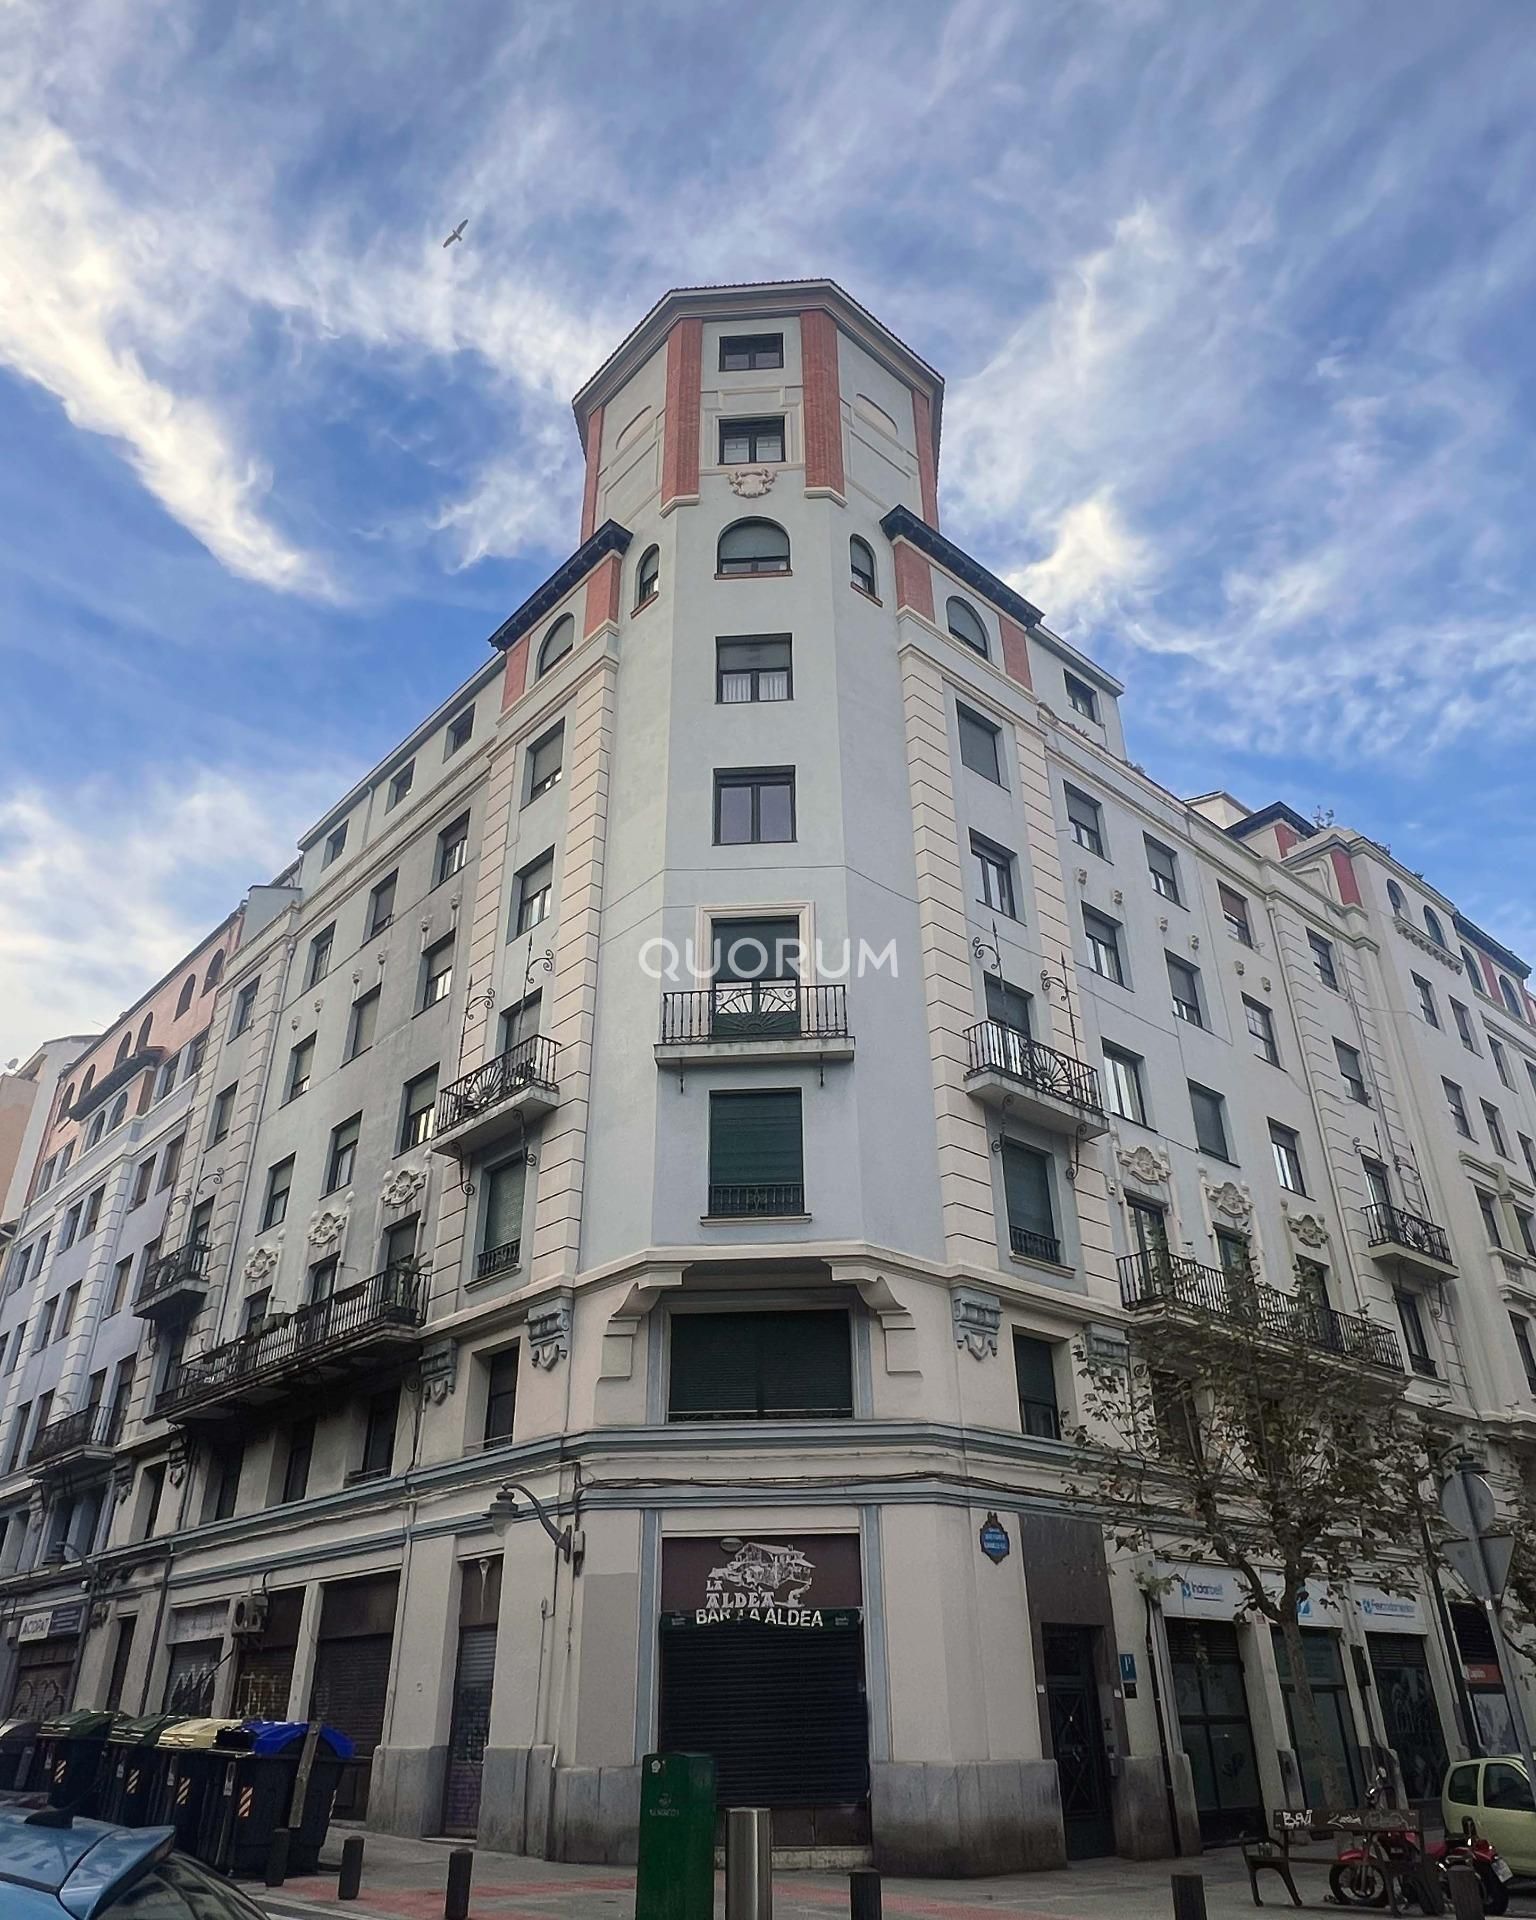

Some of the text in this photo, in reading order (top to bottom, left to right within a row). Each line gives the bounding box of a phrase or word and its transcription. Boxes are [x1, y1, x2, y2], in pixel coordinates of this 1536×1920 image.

[706, 1580, 723, 1591] LA
[706, 1591, 775, 1609] ALDEA
[696, 1608, 731, 1625] BAR
[765, 1608, 824, 1628] ALDEA
